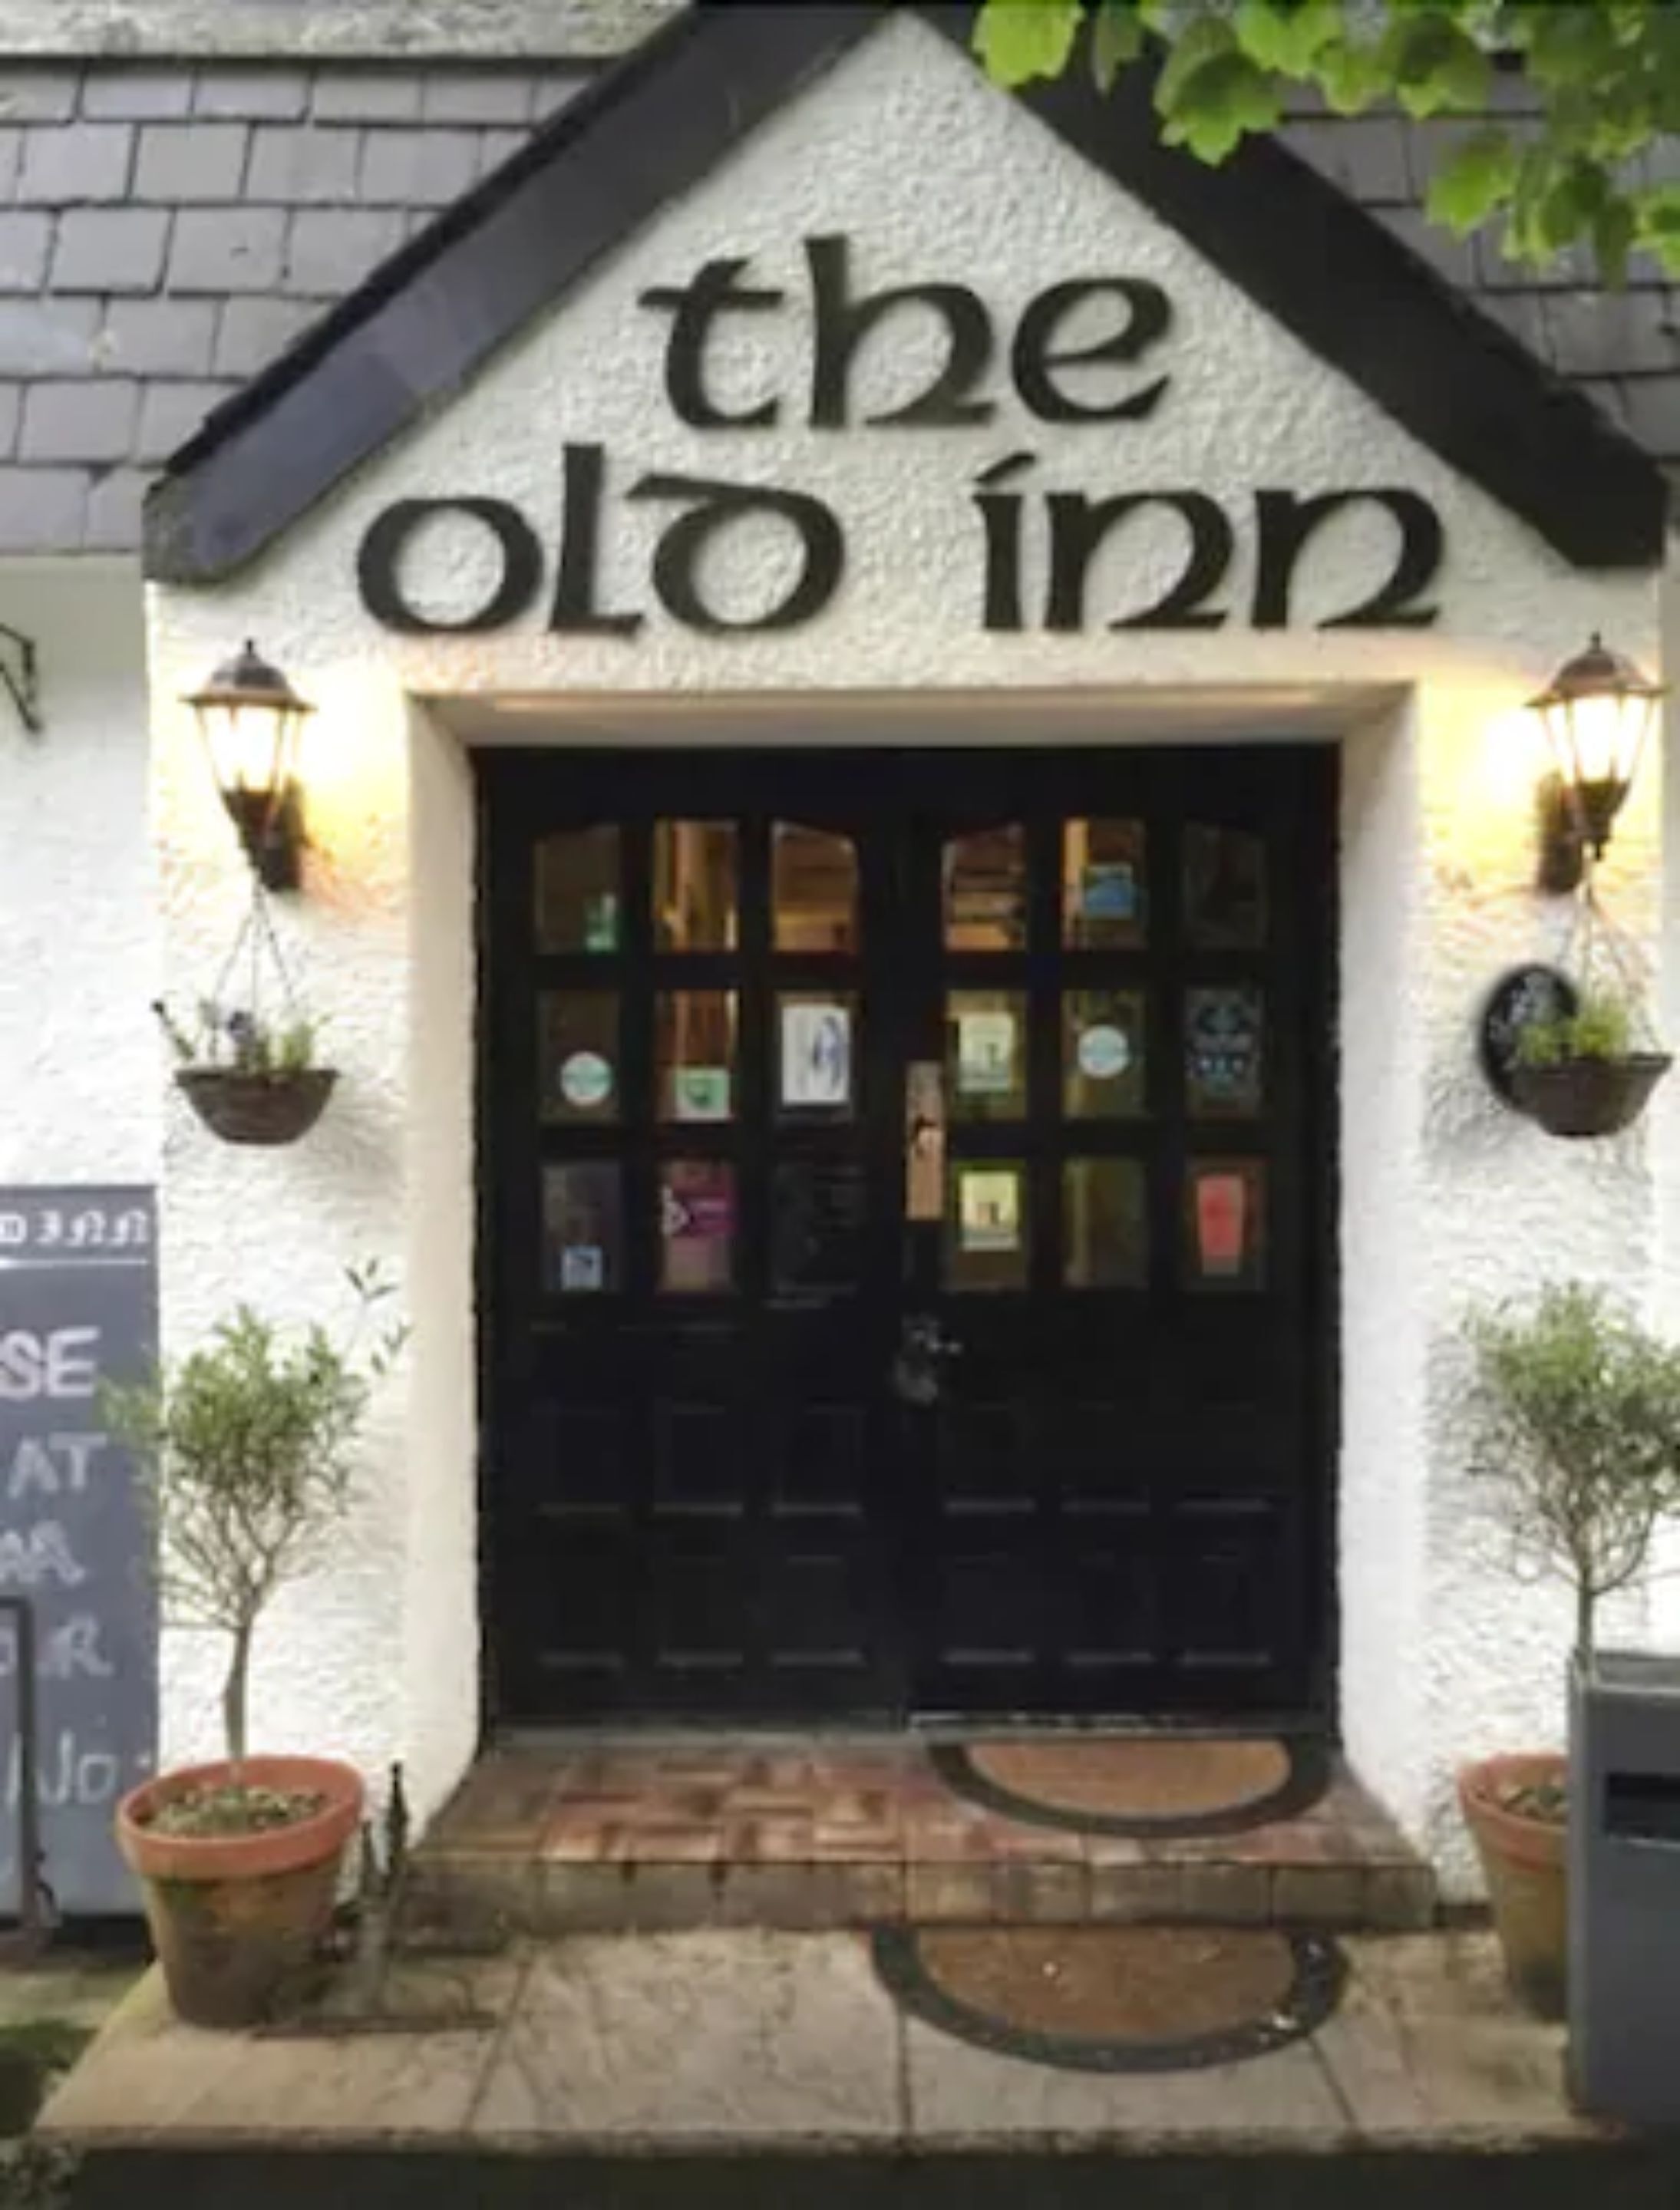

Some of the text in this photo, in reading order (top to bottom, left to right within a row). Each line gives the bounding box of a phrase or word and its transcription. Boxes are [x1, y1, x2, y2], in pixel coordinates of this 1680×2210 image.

[637, 235, 1173, 430] the
[356, 444, 1446, 635] old inn
